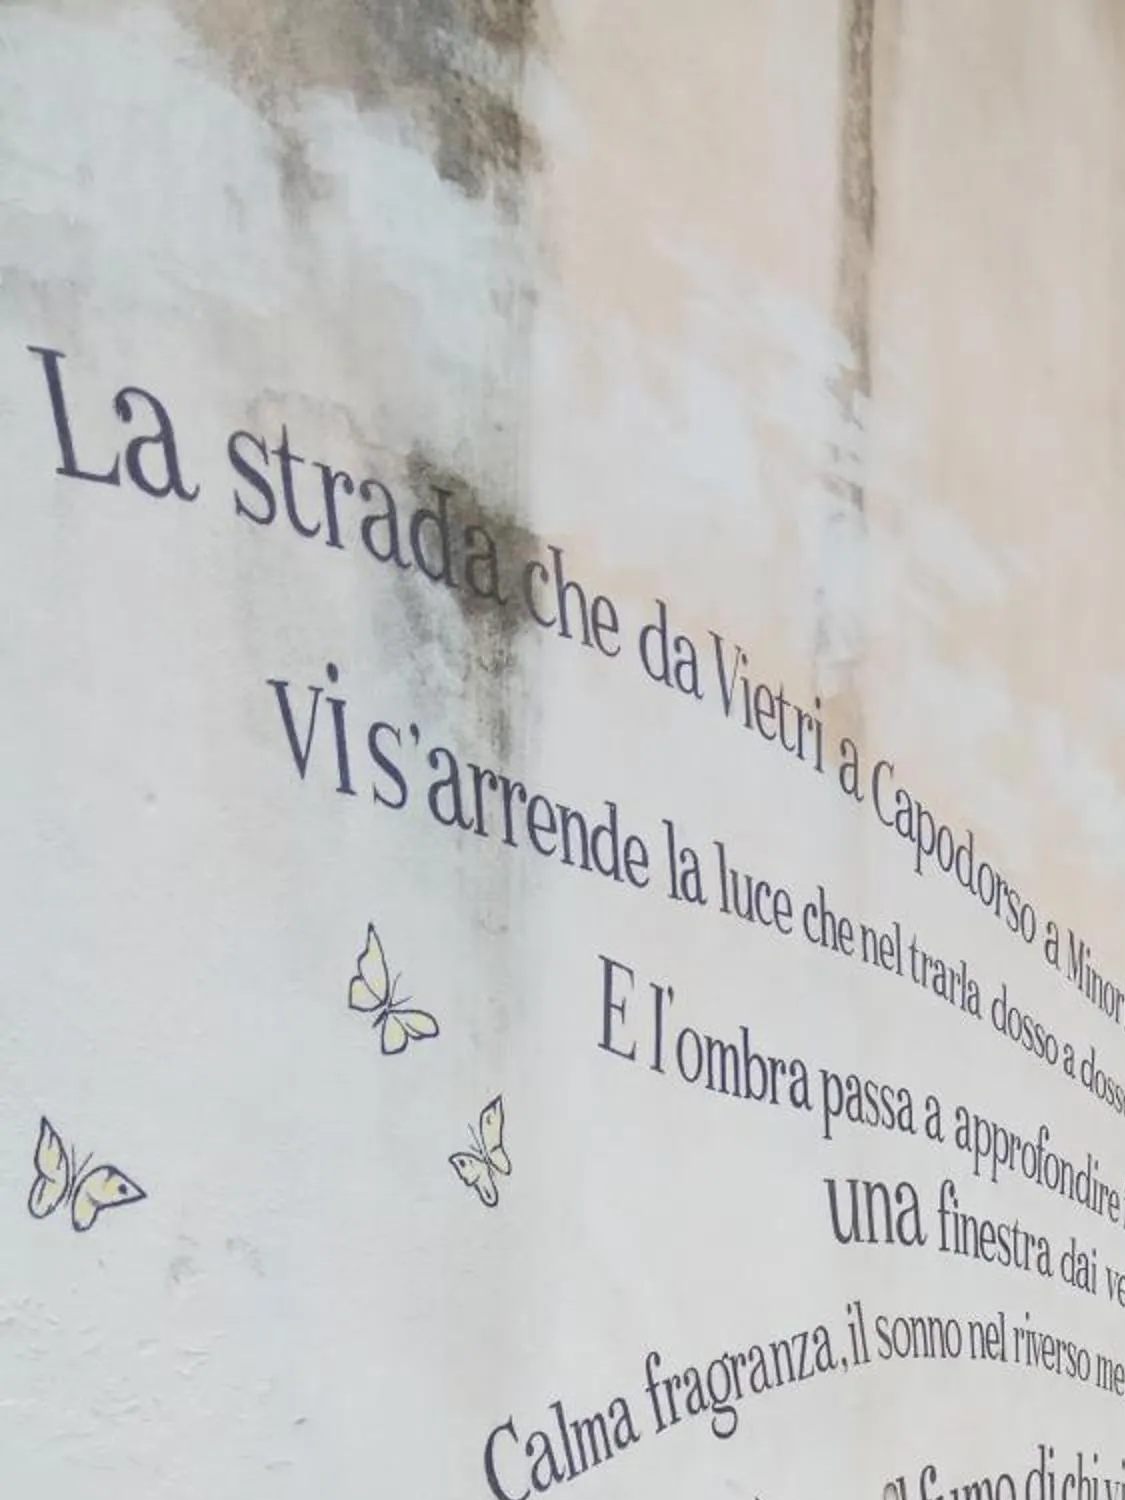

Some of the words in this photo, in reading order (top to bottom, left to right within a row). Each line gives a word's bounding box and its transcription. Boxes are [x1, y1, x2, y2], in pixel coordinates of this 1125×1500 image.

[26, 345, 200, 502] La
[226, 423, 507, 606] strada
[523, 545, 622, 658] che
[638, 599, 704, 702] da
[708, 630, 826, 774] Vietri
[838, 737, 864, 803] a
[872, 759, 1036, 945] Capodorso
[1044, 920, 1062, 968] a
[367, 720, 651, 889] s'arrende
[662, 818, 707, 907] la
[714, 840, 793, 935] luce
[803, 886, 856, 957] che
[861, 922, 905, 978] nel
[909, 932, 983, 1020] trarla
[991, 984, 1059, 1067] dosso
[1063, 1042, 1077, 1078] a
[598, 953, 637, 1063] E
[649, 982, 813, 1112] l'ombra
[819, 1068, 917, 1140] passa
[925, 1095, 945, 1144] a
[953, 1105, 1122, 1223] approfondire
[645, 1324, 848, 1440] fragranza,
[845, 1300, 871, 1366] il
[875, 1311, 964, 1361] sonno
[967, 1311, 1009, 1363] nel
[1012, 1311, 1092, 1382] riverso
[824, 1177, 928, 1248] una
[936, 1179, 1054, 1278] finestra
[1060, 1236, 1098, 1296] dai
